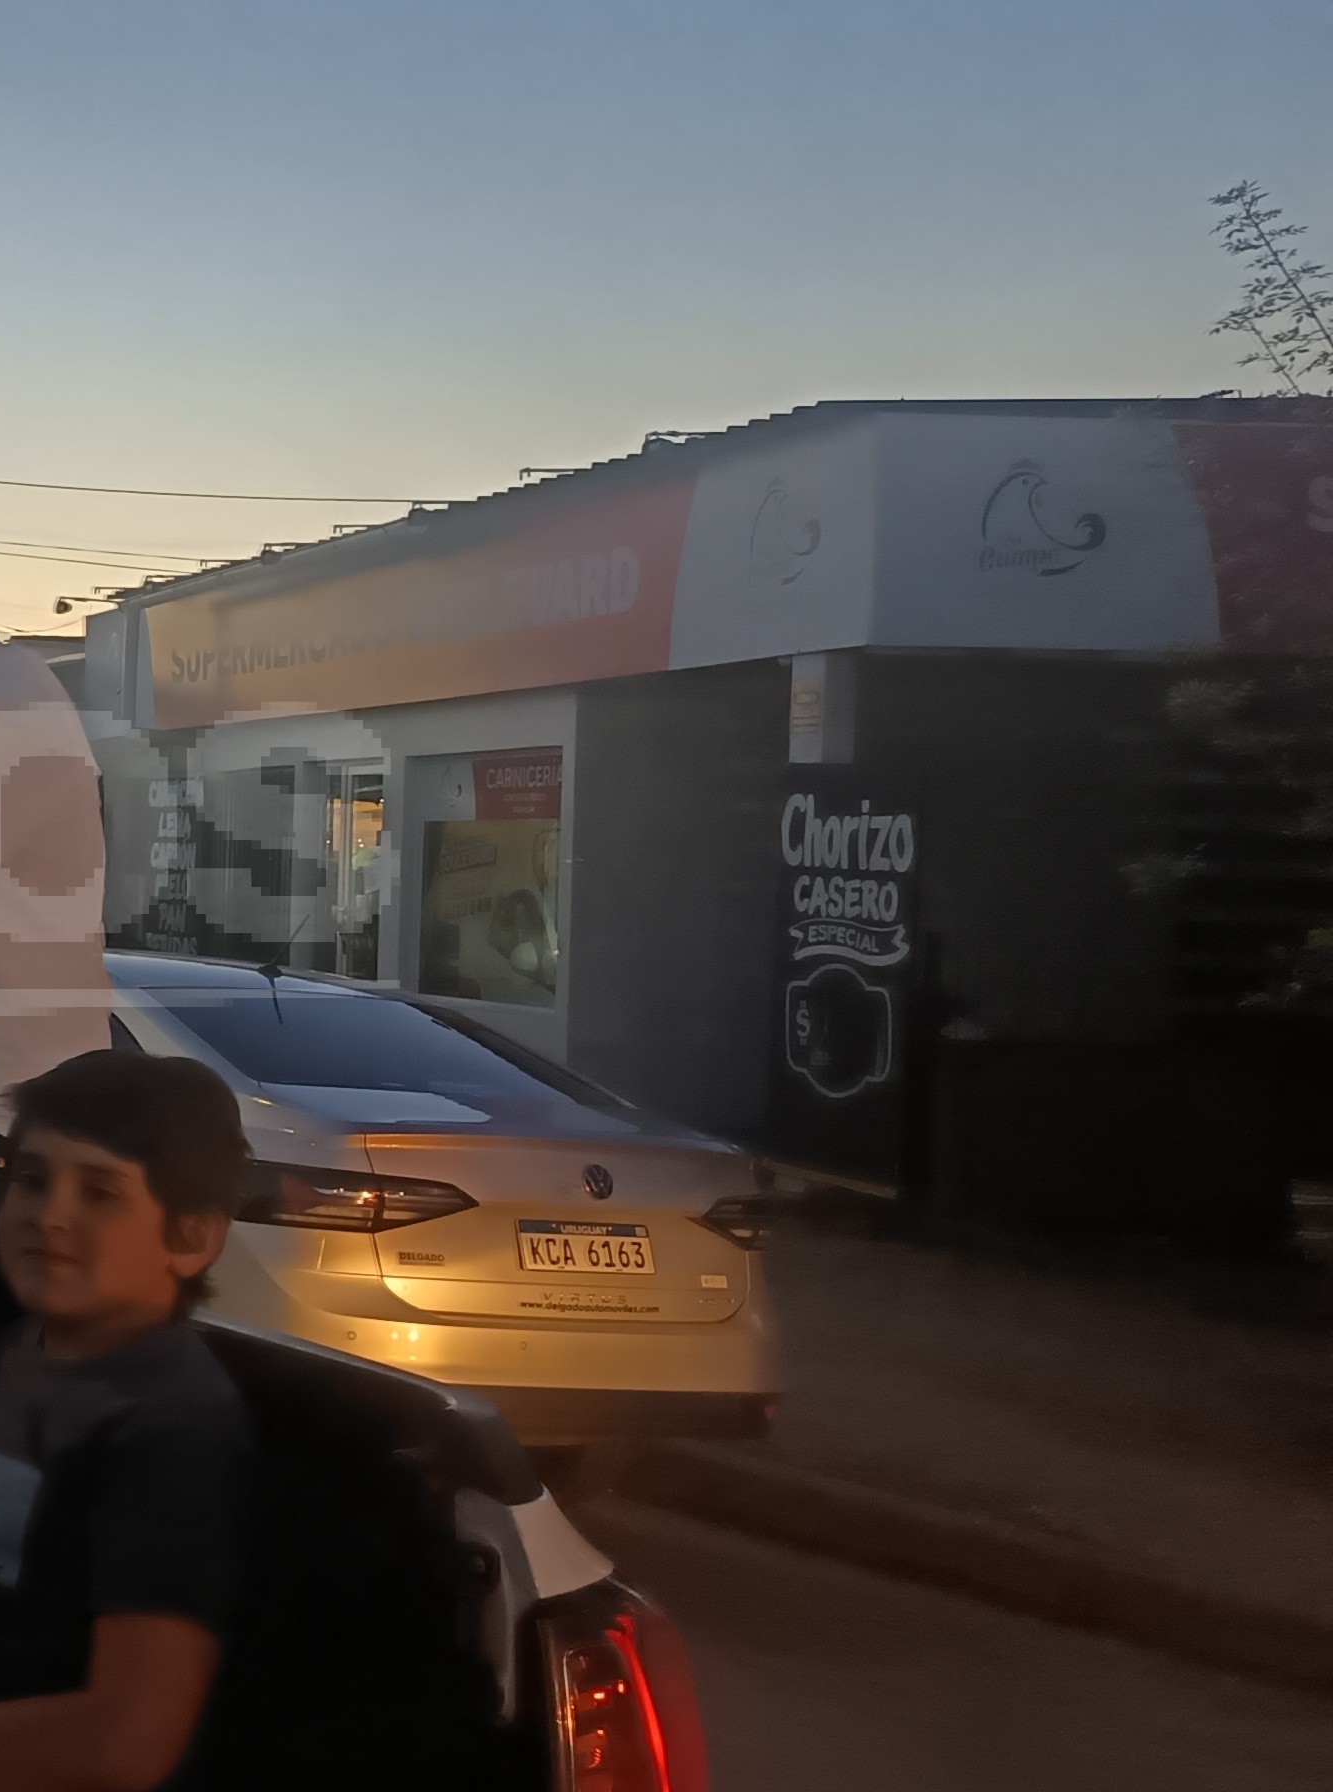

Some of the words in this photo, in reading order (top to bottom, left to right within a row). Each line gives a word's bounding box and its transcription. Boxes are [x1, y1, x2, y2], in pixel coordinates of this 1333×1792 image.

[780, 793, 913, 873] Chorizo
[793, 874, 899, 922] CASERO
[807, 924, 880, 954] ESPECIAL
[560, 1224, 608, 1235] URUGUAY
[398, 1251, 445, 1263] DELGADO
[529, 1236, 577, 1267] KCA
[587, 1240, 646, 1269] 6163
